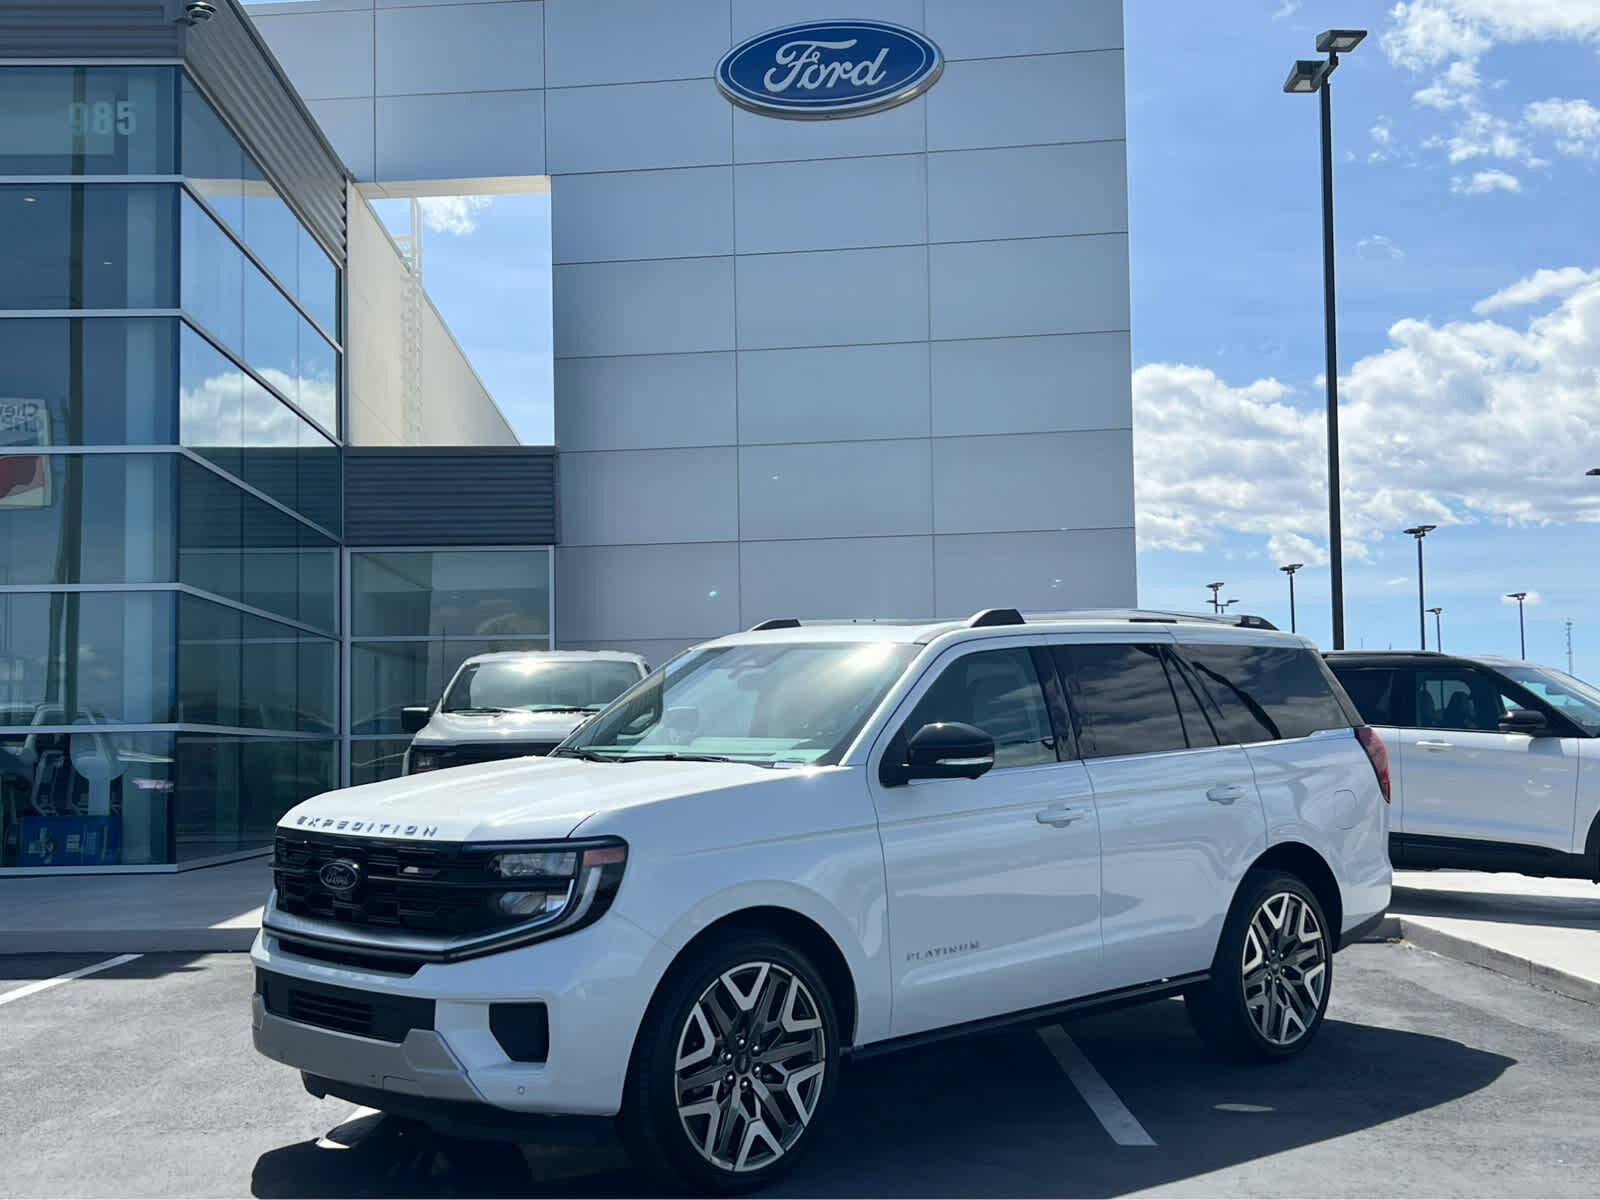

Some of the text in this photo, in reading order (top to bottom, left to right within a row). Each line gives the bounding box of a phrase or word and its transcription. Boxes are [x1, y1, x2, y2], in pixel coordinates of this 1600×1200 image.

[763, 39, 890, 93] Ford
[68, 101, 137, 136] 985
[297, 815, 438, 837] EXPEDITION
[325, 866, 350, 886] Ford
[906, 939, 980, 961] PLATINUM
